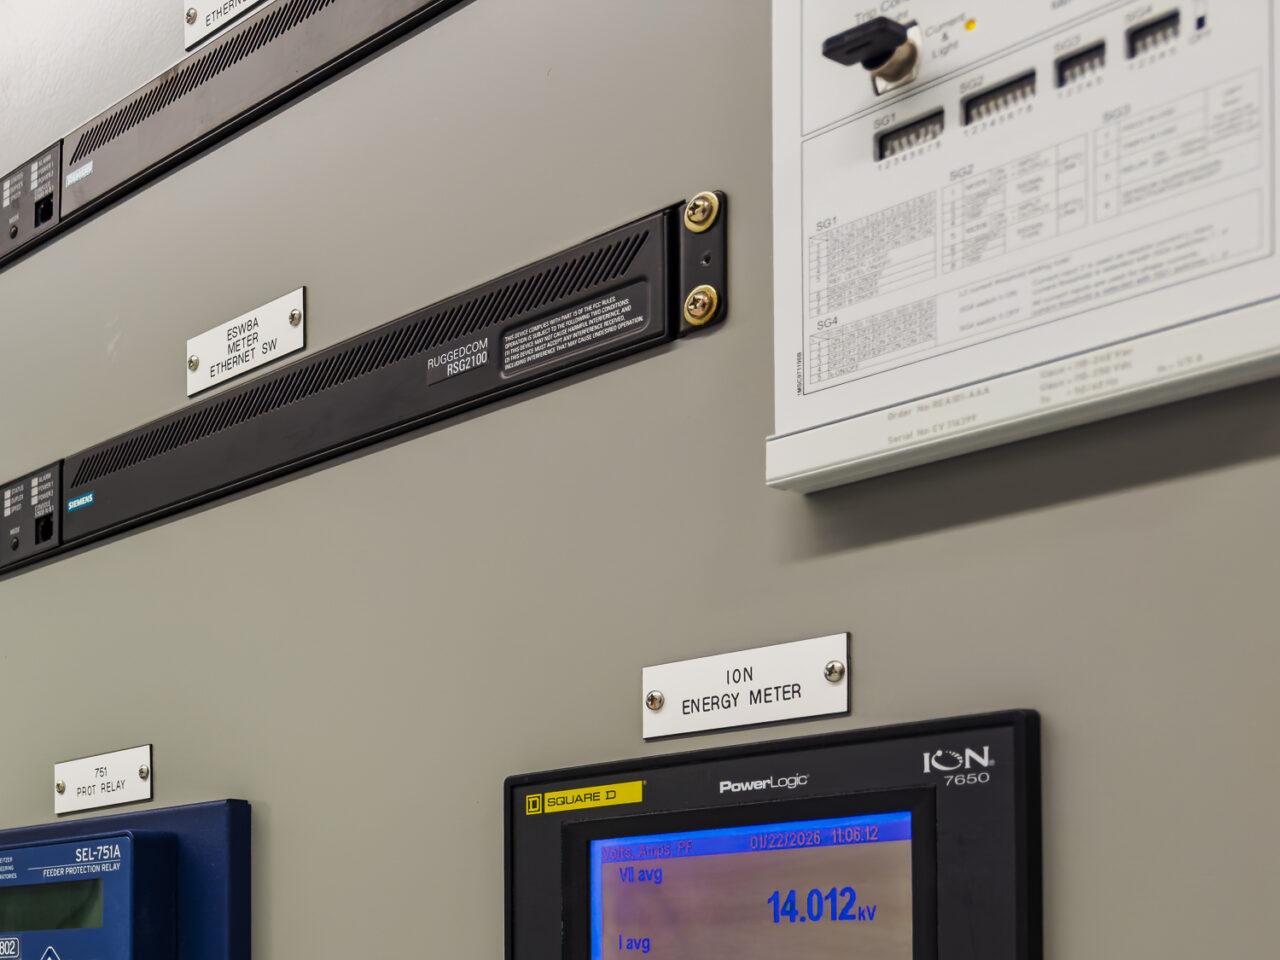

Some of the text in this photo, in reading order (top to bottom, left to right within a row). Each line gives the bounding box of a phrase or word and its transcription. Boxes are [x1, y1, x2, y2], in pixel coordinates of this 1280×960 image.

[873, 112, 896, 129] SG1
[816, 216, 837, 232] SG1
[817, 316, 838, 330] SG4
[228, 332, 259, 355] METER
[210, 338, 278, 378] ETHERNET SW
[427, 338, 488, 370] RUGGEDCOM
[447, 351, 488, 376] RSG2100
[68, 494, 93, 510] SIEMENS
[726, 666, 754, 685] ION
[682, 683, 802, 715] ENERGY METER
[922, 746, 990, 773] ION
[76, 779, 126, 797] PROT RELAY
[719, 772, 808, 794] PowerLogic
[944, 772, 990, 786] 7650
[547, 790, 616, 807] SQUARE D
[677, 840, 693, 854] PF
[750, 830, 821, 850] 01/22/2026
[830, 826, 879, 845] 11:06:12
[75, 844, 121, 862] SEL-751A
[43, 863, 121, 878] FEEDER PROTECTION RELAY
[638, 869, 663, 884] avg
[626, 937, 651, 953] avg
